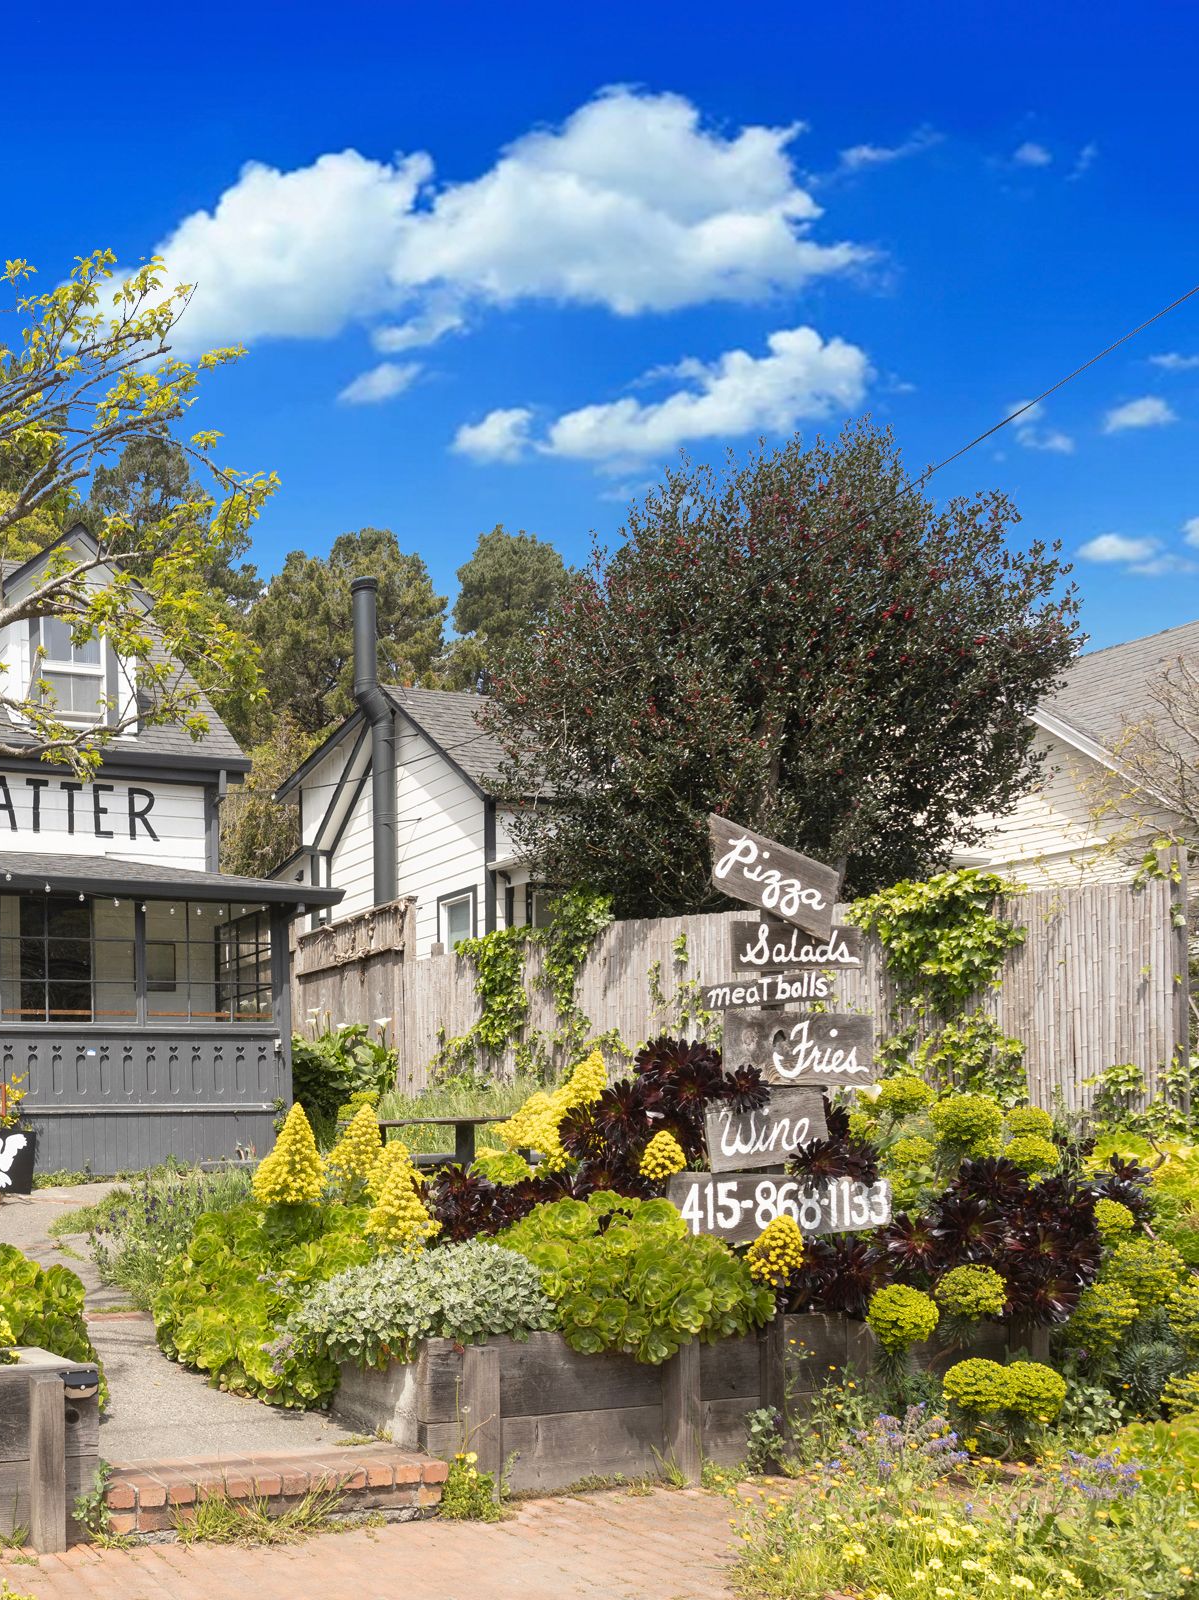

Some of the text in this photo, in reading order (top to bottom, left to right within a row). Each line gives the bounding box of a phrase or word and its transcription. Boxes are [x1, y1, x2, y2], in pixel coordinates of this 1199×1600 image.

[715, 834, 827, 916] Pizza
[739, 923, 860, 965] Salads
[773, 1020, 869, 1078] Fries
[718, 1107, 816, 1157] Wine
[680, 1179, 890, 1236] 415-868-1133
